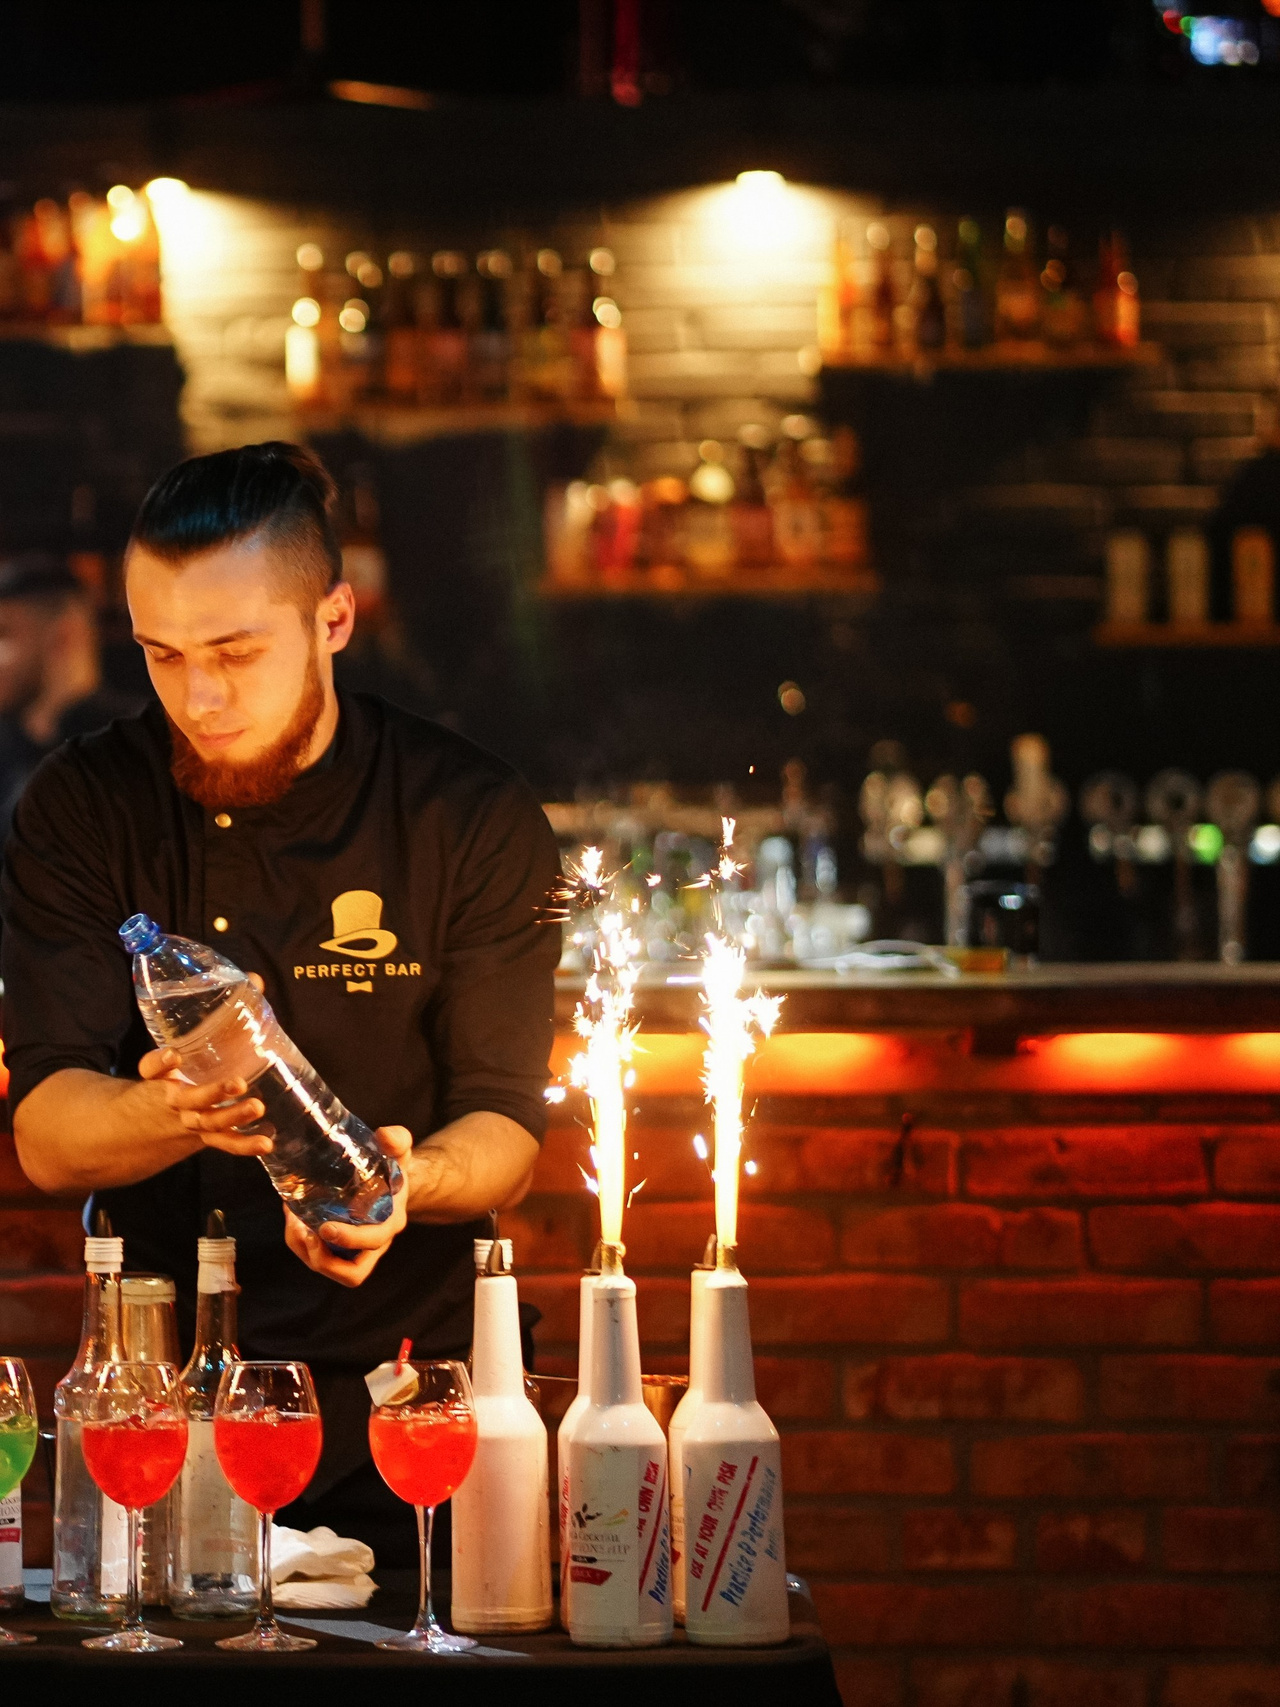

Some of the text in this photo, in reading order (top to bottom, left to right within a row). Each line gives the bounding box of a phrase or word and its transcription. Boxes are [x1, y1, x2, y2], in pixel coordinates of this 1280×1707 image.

[293, 962, 422, 980] PERFECT BAR
[698, 1513, 719, 1543] YOUR
[694, 1541, 710, 1561] AT
[719, 1554, 755, 1608] Practice
